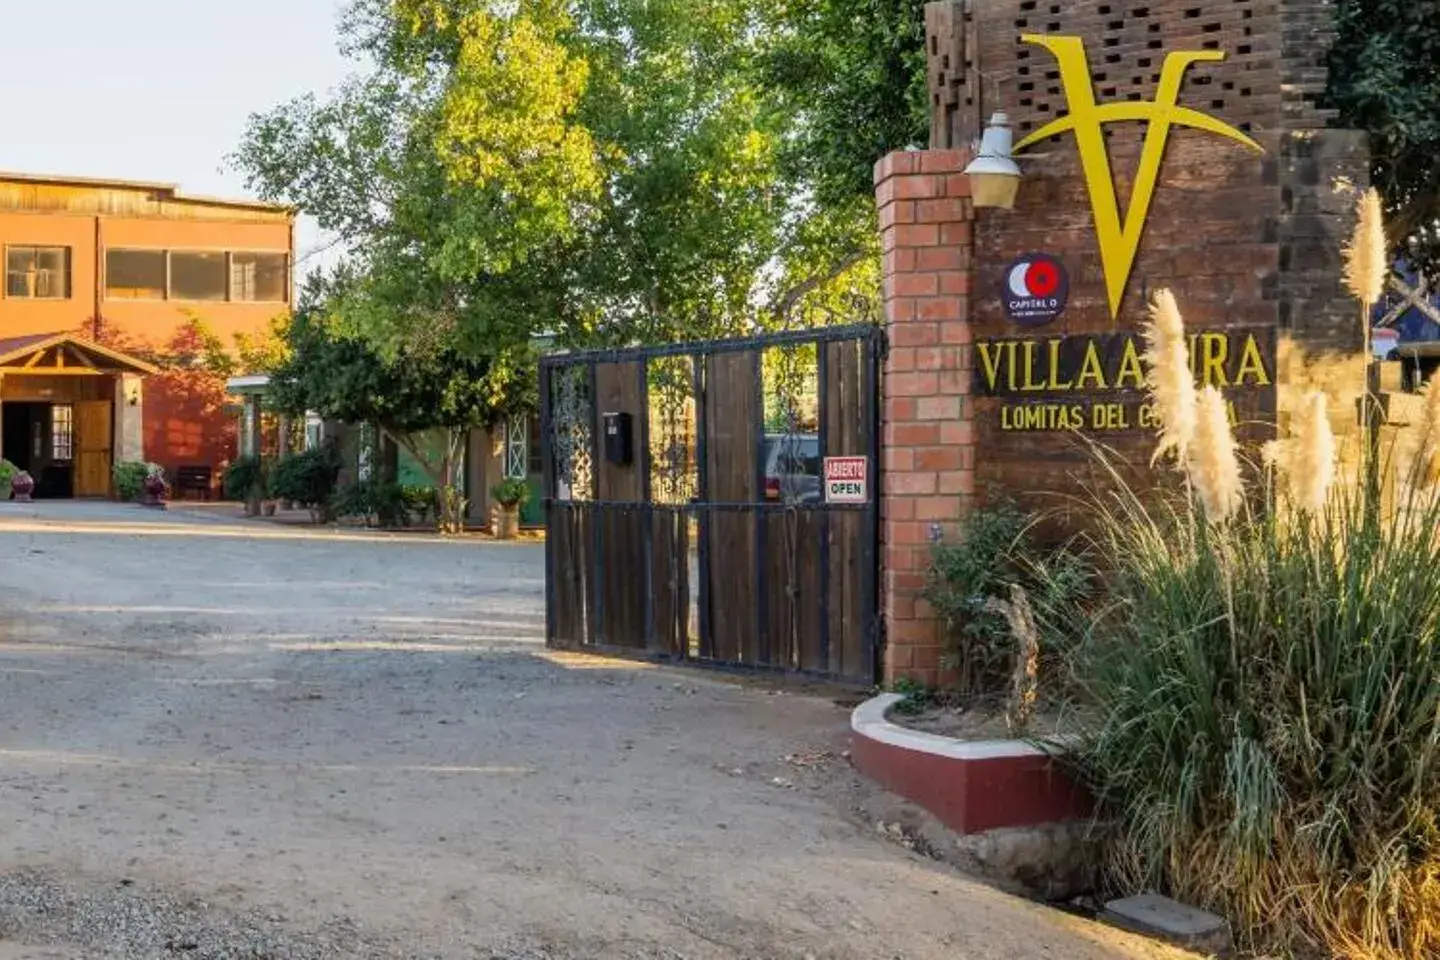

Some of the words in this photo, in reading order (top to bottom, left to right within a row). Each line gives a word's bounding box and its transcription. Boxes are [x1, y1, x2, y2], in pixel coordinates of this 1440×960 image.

[977, 339, 1109, 391] VILLA
[1001, 403, 1084, 430] LOMITAS
[1093, 402, 1129, 429] DEL
[831, 483, 861, 494] OPEN
